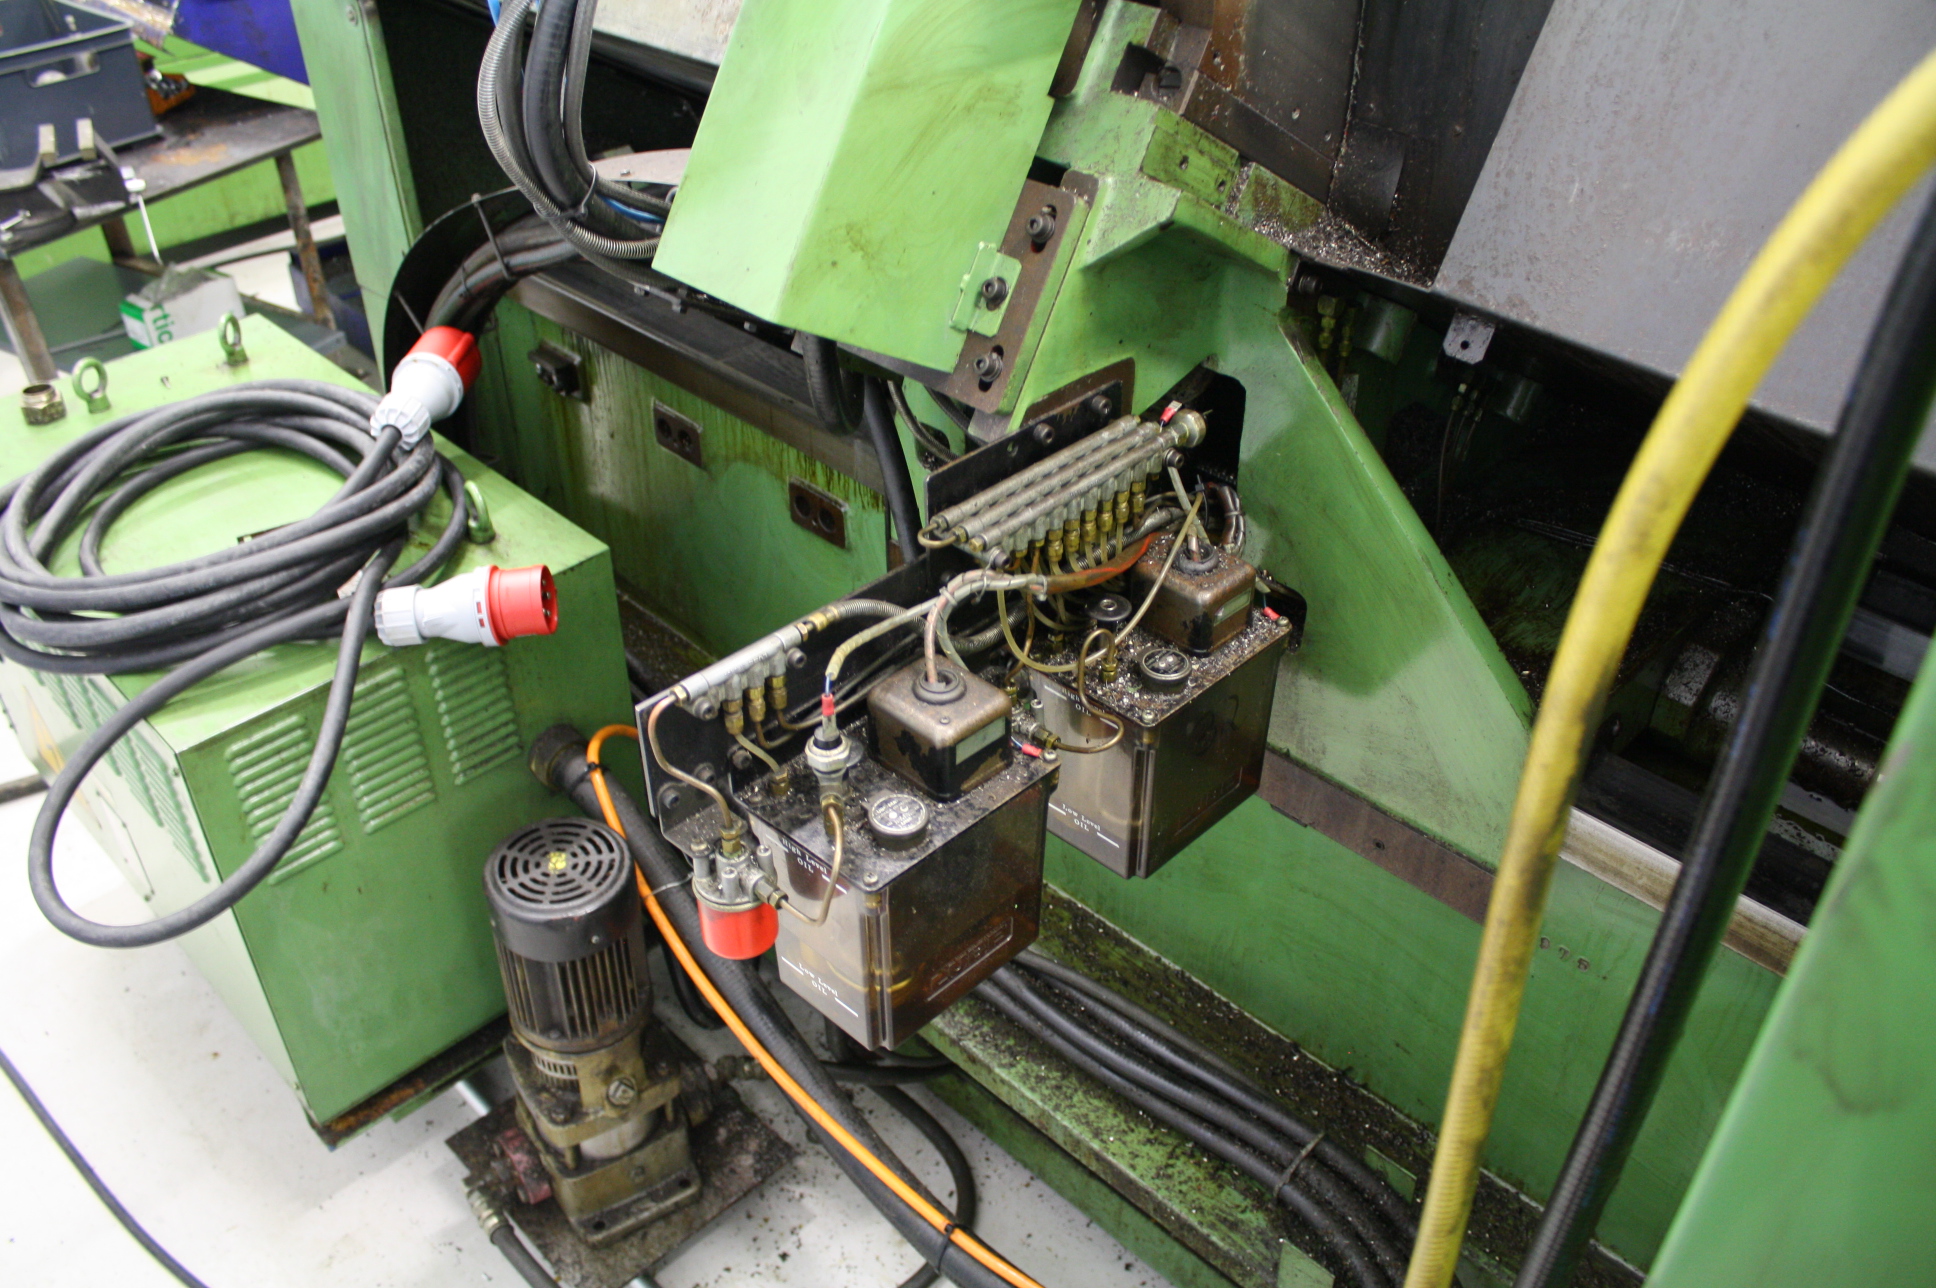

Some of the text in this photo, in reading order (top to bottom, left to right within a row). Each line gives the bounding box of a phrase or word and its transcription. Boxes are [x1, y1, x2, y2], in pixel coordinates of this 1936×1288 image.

[1062, 803, 1101, 831] Low Level
[1073, 818, 1090, 832] OIL
[797, 856, 814, 874] OIL
[805, 853, 828, 875] Level
[798, 962, 839, 998] Low Level
[811, 980, 828, 996] OIL
